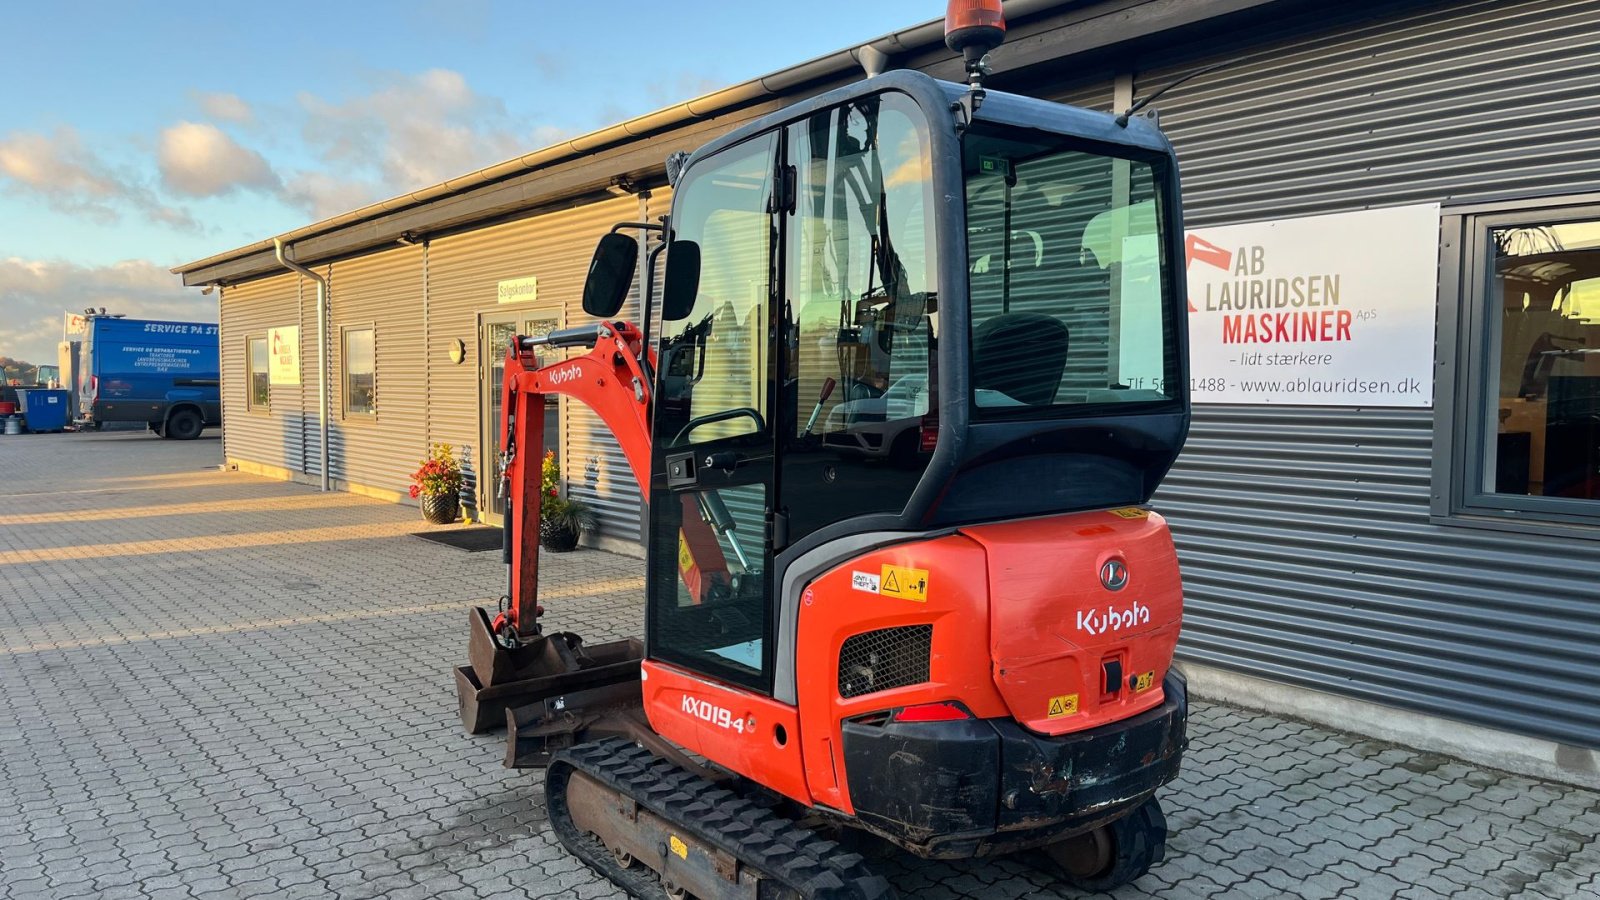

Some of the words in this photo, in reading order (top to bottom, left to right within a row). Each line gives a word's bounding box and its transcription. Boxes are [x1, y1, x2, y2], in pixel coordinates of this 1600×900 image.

[1234, 245, 1265, 277] AB
[499, 282, 535, 299] Salgskontor
[1205, 274, 1340, 312] LAURIDSEN
[144, 323, 187, 333] SERVICE
[190, 325, 203, 335] PÅ
[205, 326, 219, 335] ST
[1222, 309, 1352, 344] MASKINER
[1356, 308, 1377, 323] ApS
[1240, 352, 1263, 366] lidt
[1265, 353, 1333, 366] stærkere
[549, 364, 582, 385] Kubota
[1190, 378, 1226, 392] 1488
[1240, 378, 1421, 394] www.ablauridsen.dk
[1076, 600, 1150, 635] Kubota
